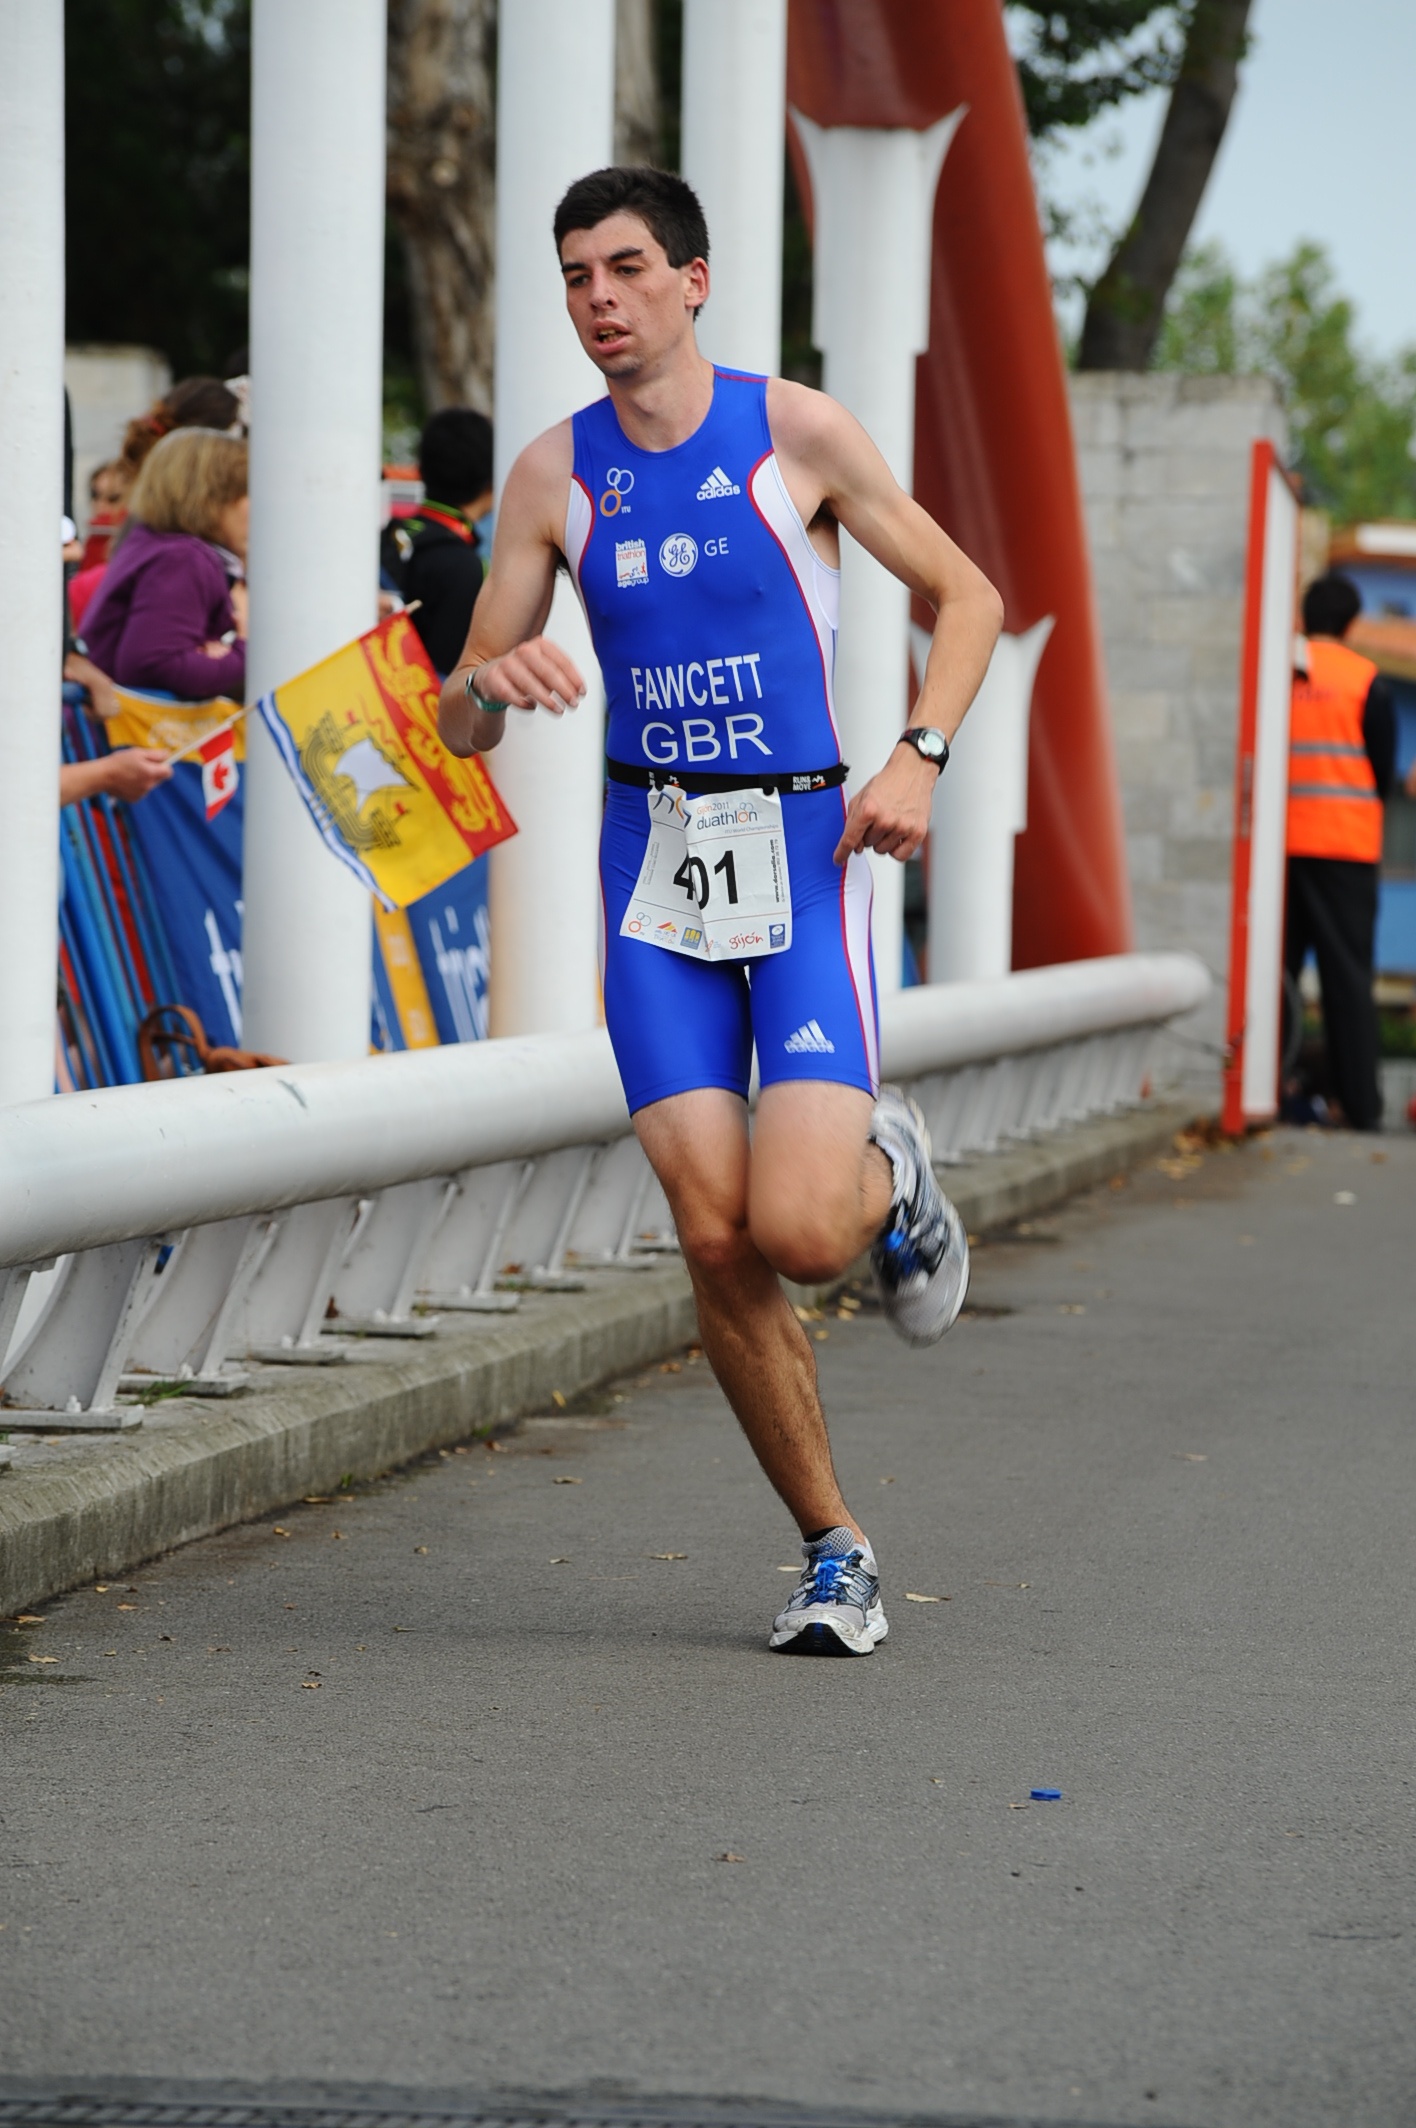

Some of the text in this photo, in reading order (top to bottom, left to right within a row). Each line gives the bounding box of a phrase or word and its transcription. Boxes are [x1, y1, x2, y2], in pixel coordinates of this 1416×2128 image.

[696, 483, 741, 501] adidas
[621, 505, 632, 514] ITU
[615, 539, 646, 552] british
[703, 537, 729, 557] GE
[617, 550, 646, 561] triathlon
[630, 653, 763, 710] FAWCETT
[641, 713, 774, 765] GBR
[792, 783, 812, 792] MOVE
[696, 810, 758, 831] duathlon
[728, 931, 764, 950] gijón
[783, 1037, 836, 1054] adidas
